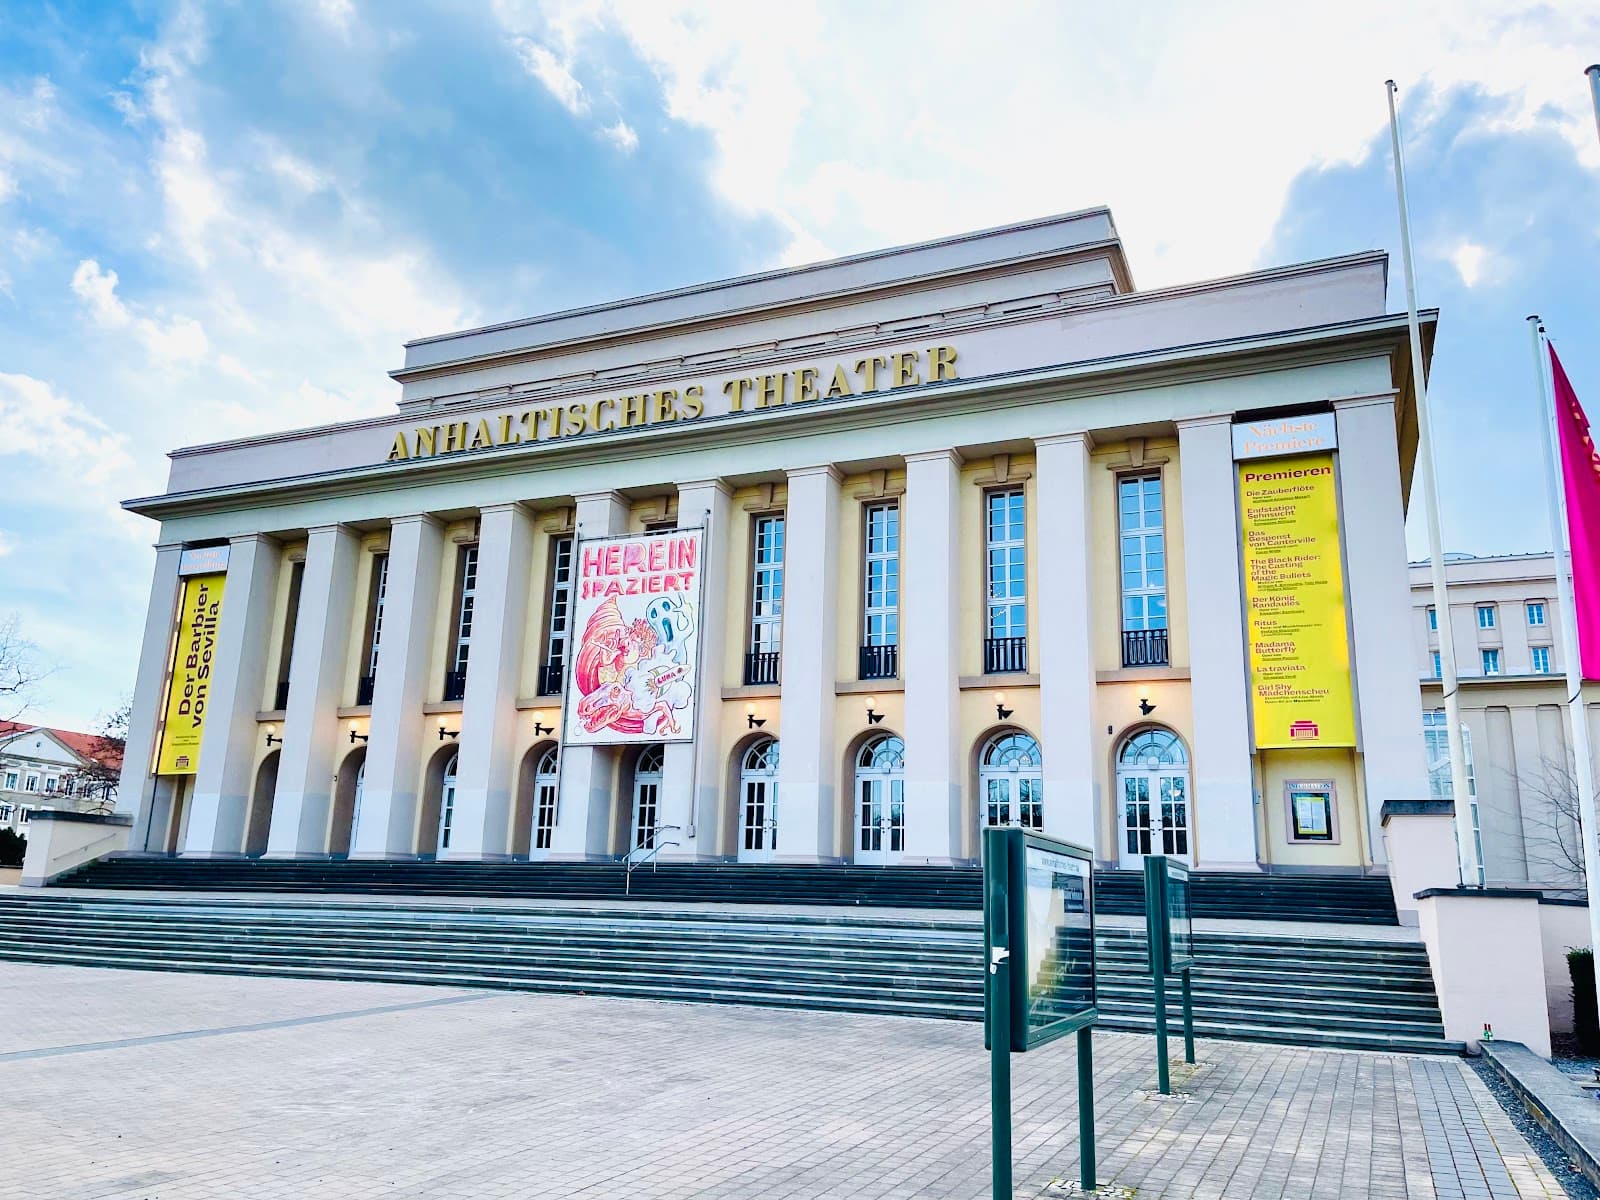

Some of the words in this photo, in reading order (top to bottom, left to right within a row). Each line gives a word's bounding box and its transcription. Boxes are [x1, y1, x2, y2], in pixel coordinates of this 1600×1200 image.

[386, 385, 704, 461] ANHALTISCHES
[722, 345, 960, 413] THEATER
[1245, 466, 1331, 483] Premieren
[1247, 504, 1296, 514] Endstation
[1247, 510, 1295, 519] Sehnsucht
[1248, 533, 1291, 542] Gespenst
[1267, 536, 1316, 546] Canterville
[583, 536, 696, 577] HEREIN
[1267, 556, 1293, 564] Black
[1279, 572, 1312, 580] Bullets
[581, 571, 695, 600] SPAZIERT
[186, 584, 209, 669] Barbier
[197, 600, 220, 679] Sevilla
[1268, 664, 1306, 672] traviata
[179, 673, 195, 715] Der
[192, 685, 207, 728] von
